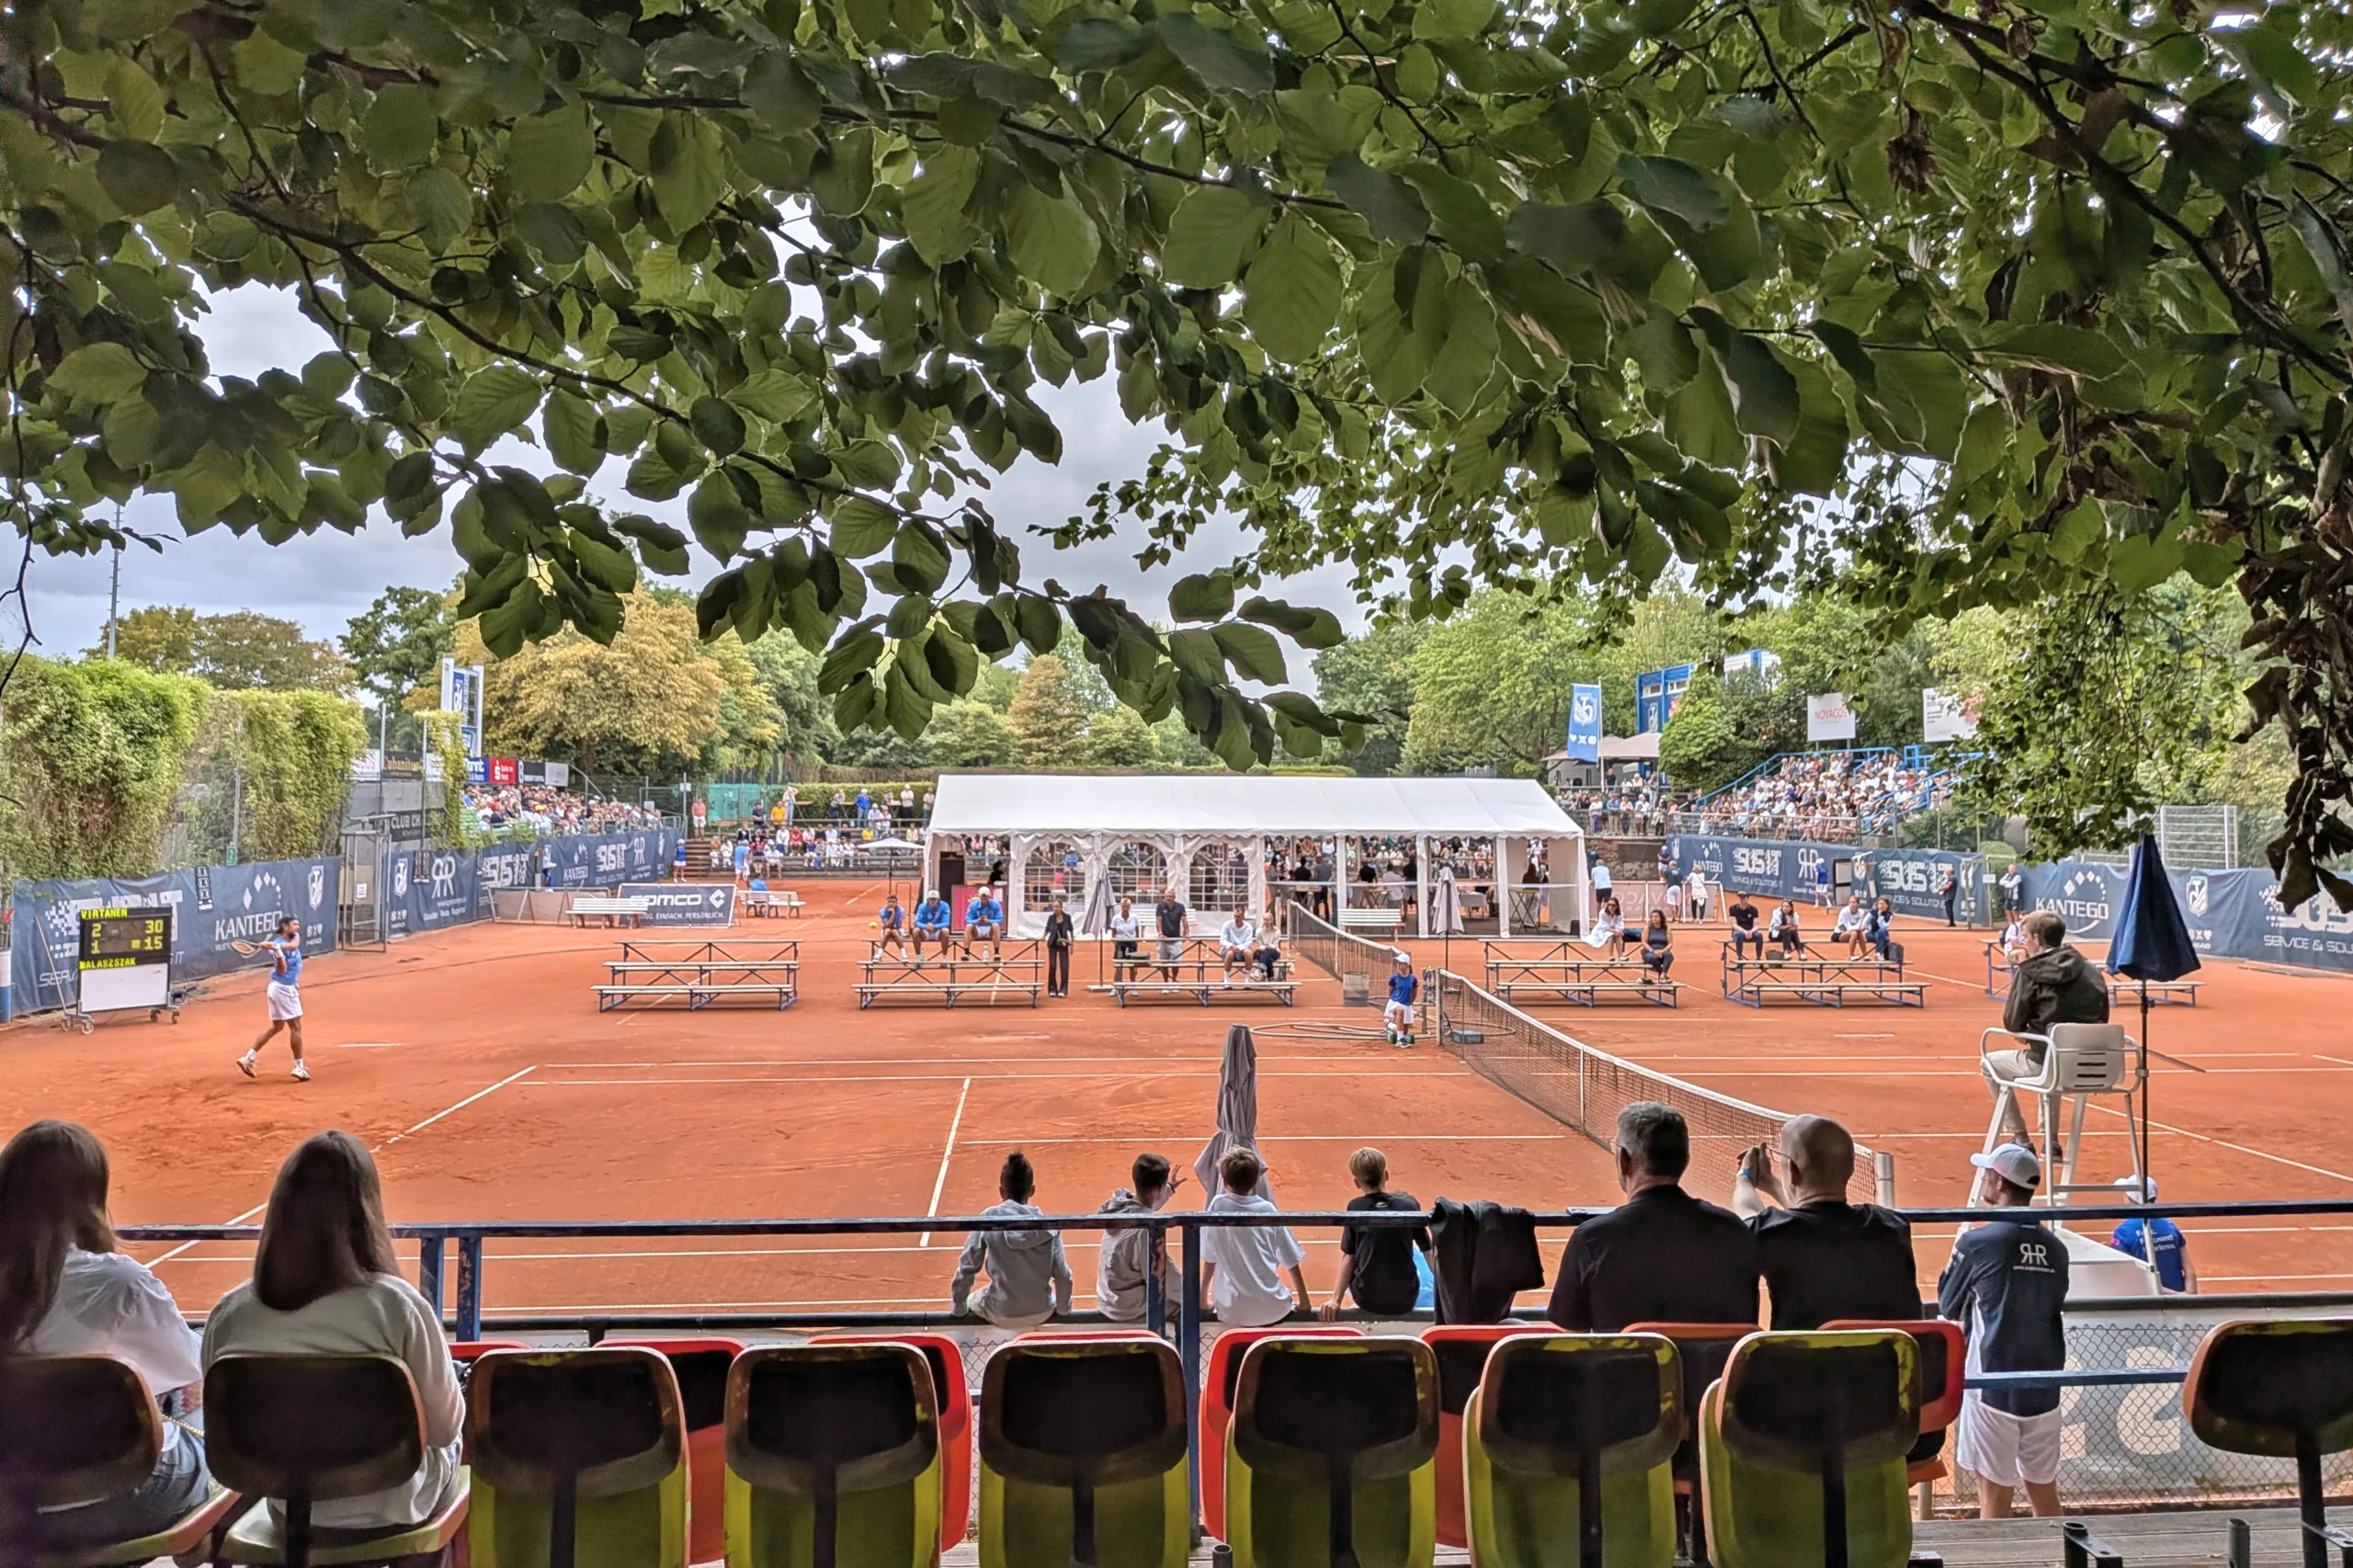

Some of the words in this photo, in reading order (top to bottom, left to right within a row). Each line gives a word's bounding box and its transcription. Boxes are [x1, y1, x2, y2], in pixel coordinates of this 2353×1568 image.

[391, 814, 411, 829] CLUB
[81, 908, 128, 919] VIRTANEN
[92, 923, 102, 938] 2
[145, 920, 164, 935] 30
[91, 940, 100, 954] 1
[144, 936, 163, 950] 15
[2264, 935, 2310, 950] SERVICE
[2313, 939, 2324, 951] &
